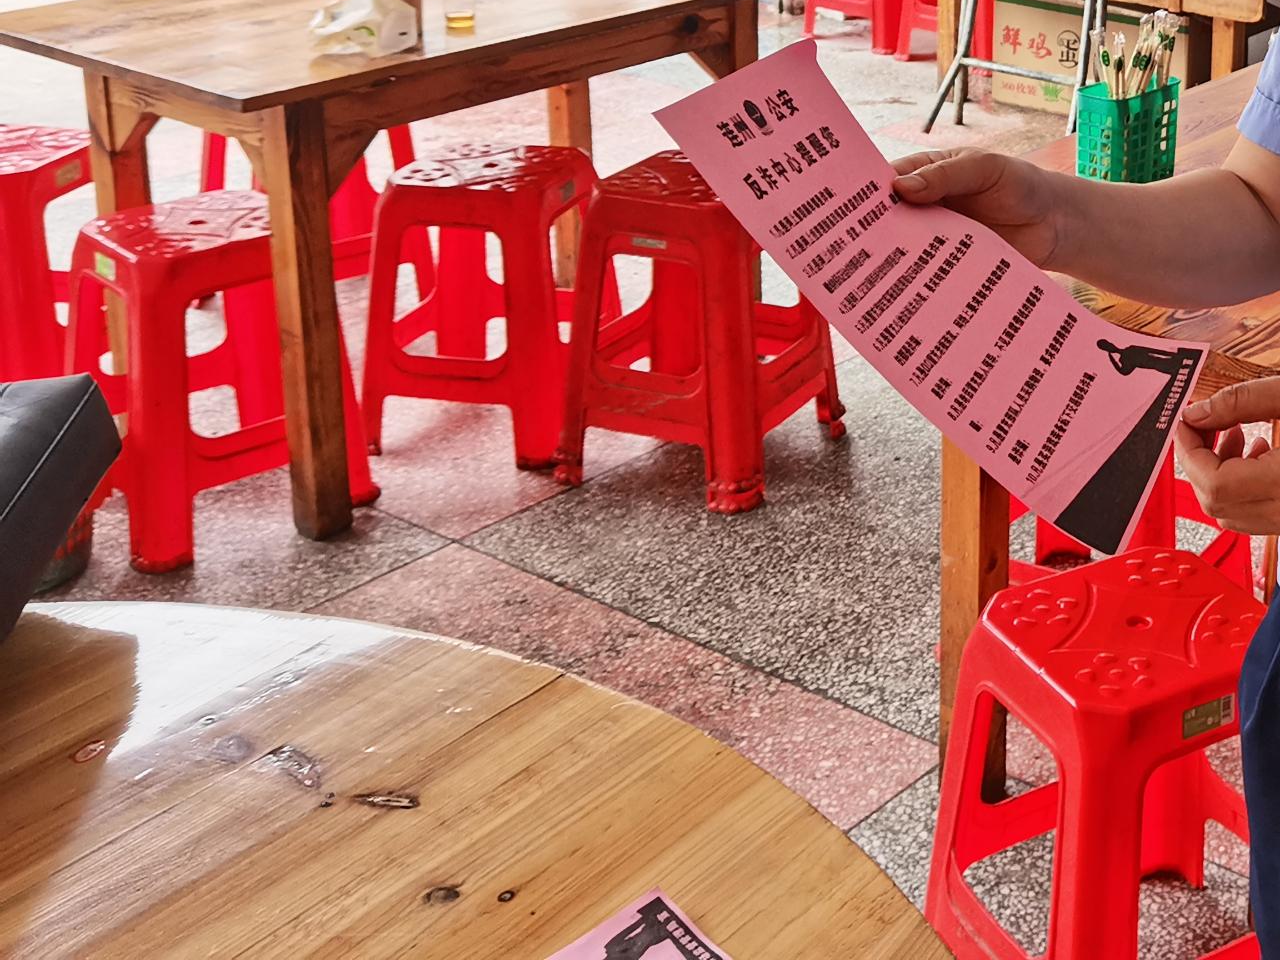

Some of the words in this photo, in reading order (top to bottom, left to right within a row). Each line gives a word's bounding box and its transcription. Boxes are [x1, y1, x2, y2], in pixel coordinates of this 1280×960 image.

[743, 125, 841, 201] 反诈中心提醒您
